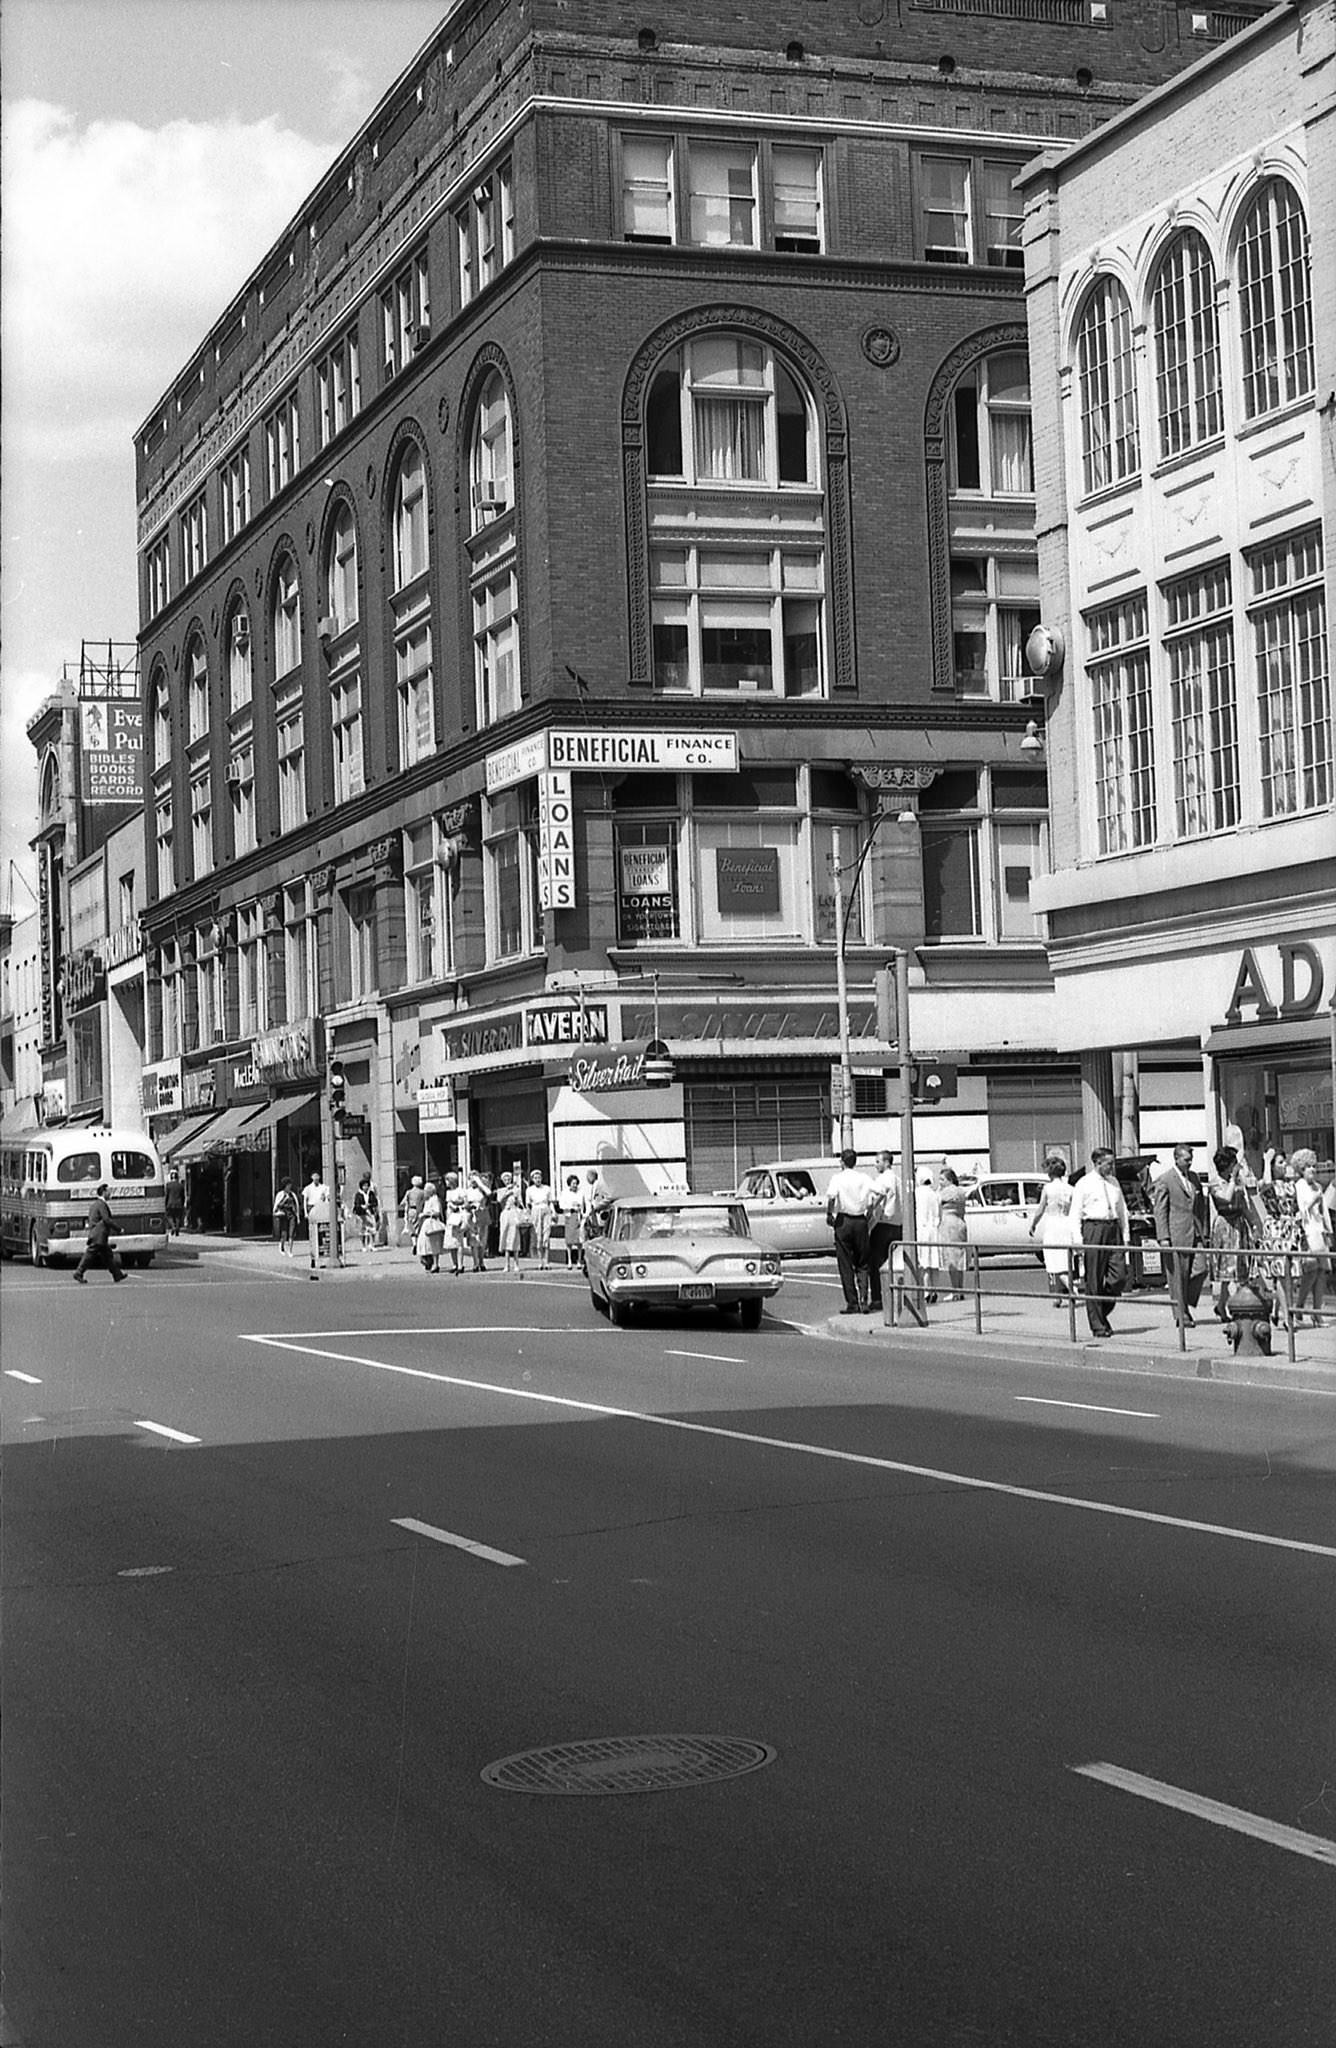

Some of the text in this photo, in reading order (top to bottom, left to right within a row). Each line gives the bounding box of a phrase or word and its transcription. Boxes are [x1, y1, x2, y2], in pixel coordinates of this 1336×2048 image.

[89, 753, 135, 764] BIBLES
[552, 737, 732, 763] BENEFICIAL FINANCE
[685, 753, 712, 764] CO.
[89, 764, 135, 774] BOOKS
[90, 775, 135, 785] CARDS
[539, 777, 549, 905] LOANS
[551, 775, 570, 904] LOANS
[720, 857, 775, 875] Beneficial
[632, 873, 660, 887] LOANS
[731, 881, 765, 894] Loans
[622, 896, 672, 908] LOANS
[1225, 942, 1336, 1024] AD
[527, 1010, 606, 1041] TAVERN
[461, 1027, 498, 1057] SILVER
[573, 1053, 644, 1091] Silver Rail
